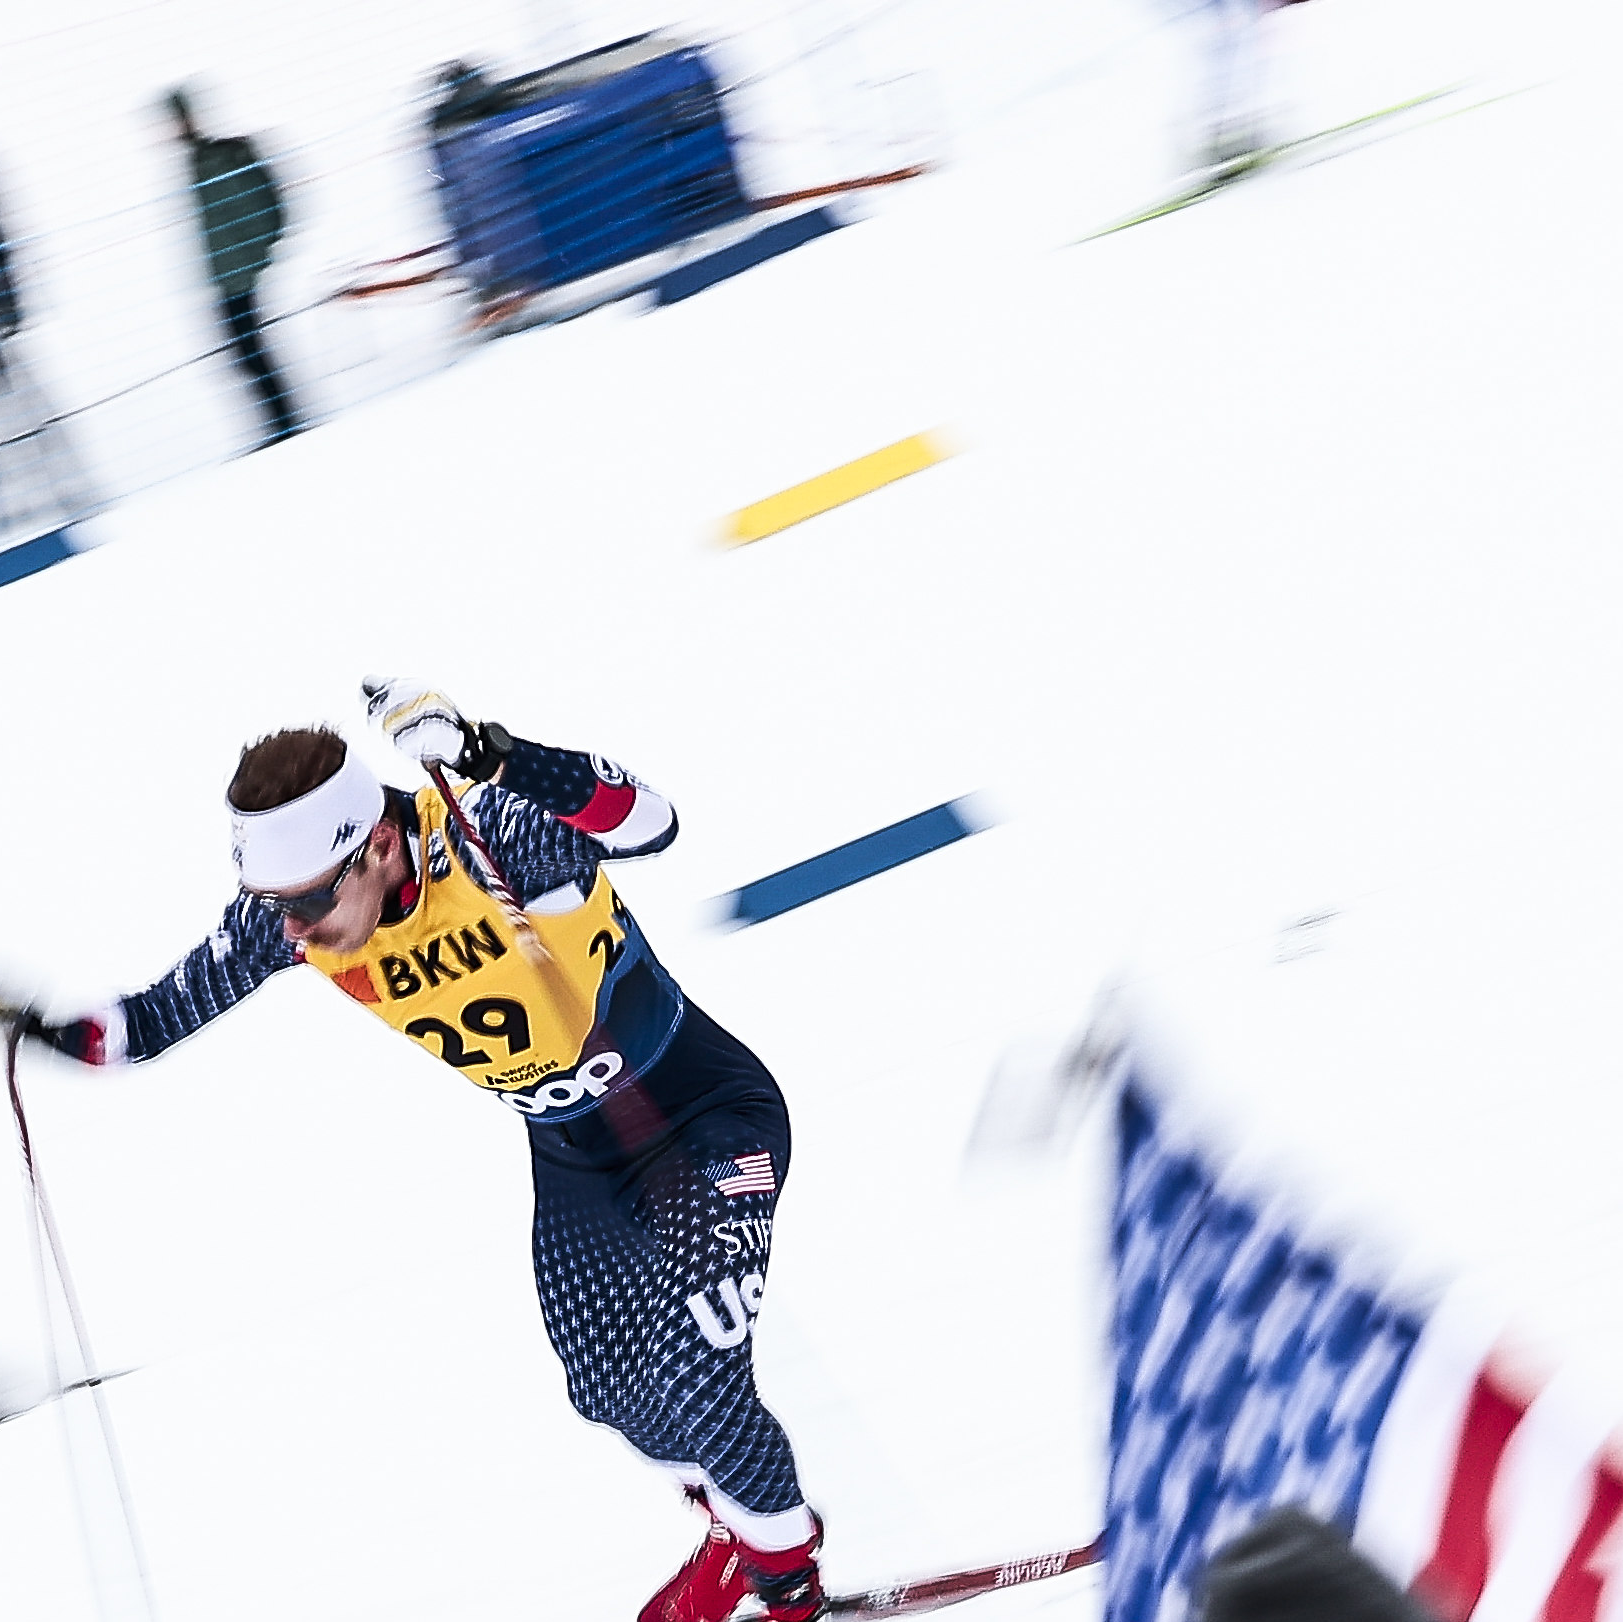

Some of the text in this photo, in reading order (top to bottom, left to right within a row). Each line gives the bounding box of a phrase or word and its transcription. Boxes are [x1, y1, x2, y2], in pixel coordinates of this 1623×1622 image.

[379, 917, 508, 1000] BKW
[405, 997, 531, 1067] 29
[500, 1051, 623, 1114] oop
[685, 1273, 764, 1349] US
